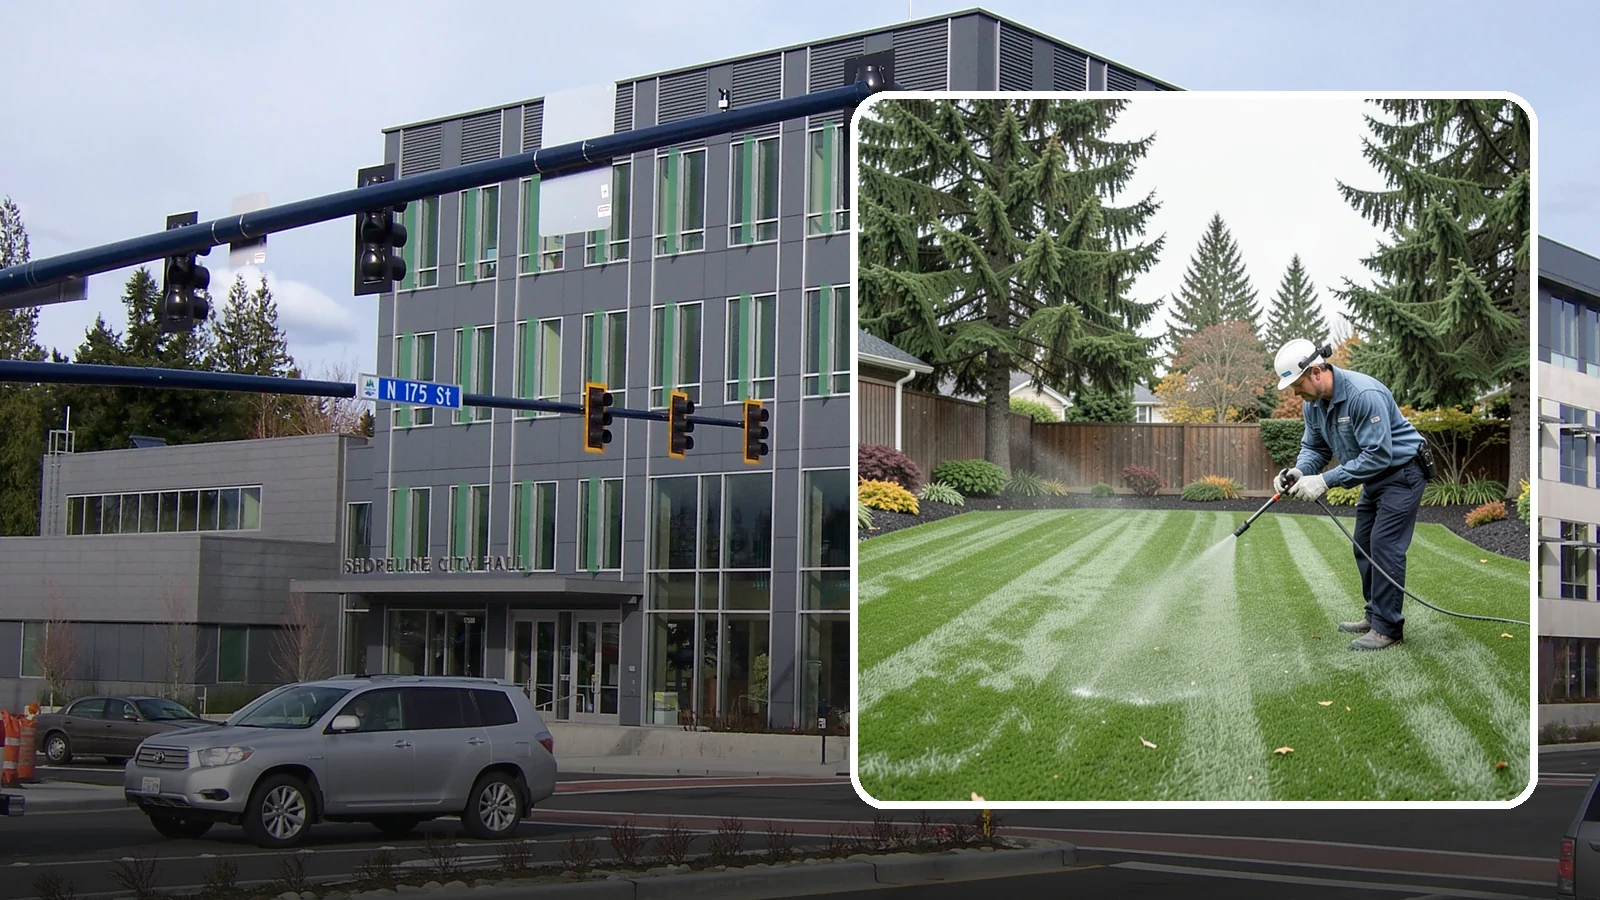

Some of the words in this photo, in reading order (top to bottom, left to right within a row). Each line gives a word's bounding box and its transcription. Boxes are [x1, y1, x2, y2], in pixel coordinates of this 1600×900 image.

[387, 381, 396, 399] N
[405, 383, 427, 403] 175
[436, 386, 451, 406] St
[344, 557, 432, 574] SHORELINE
[438, 556, 476, 572] CITY
[484, 556, 525, 571] HALL
